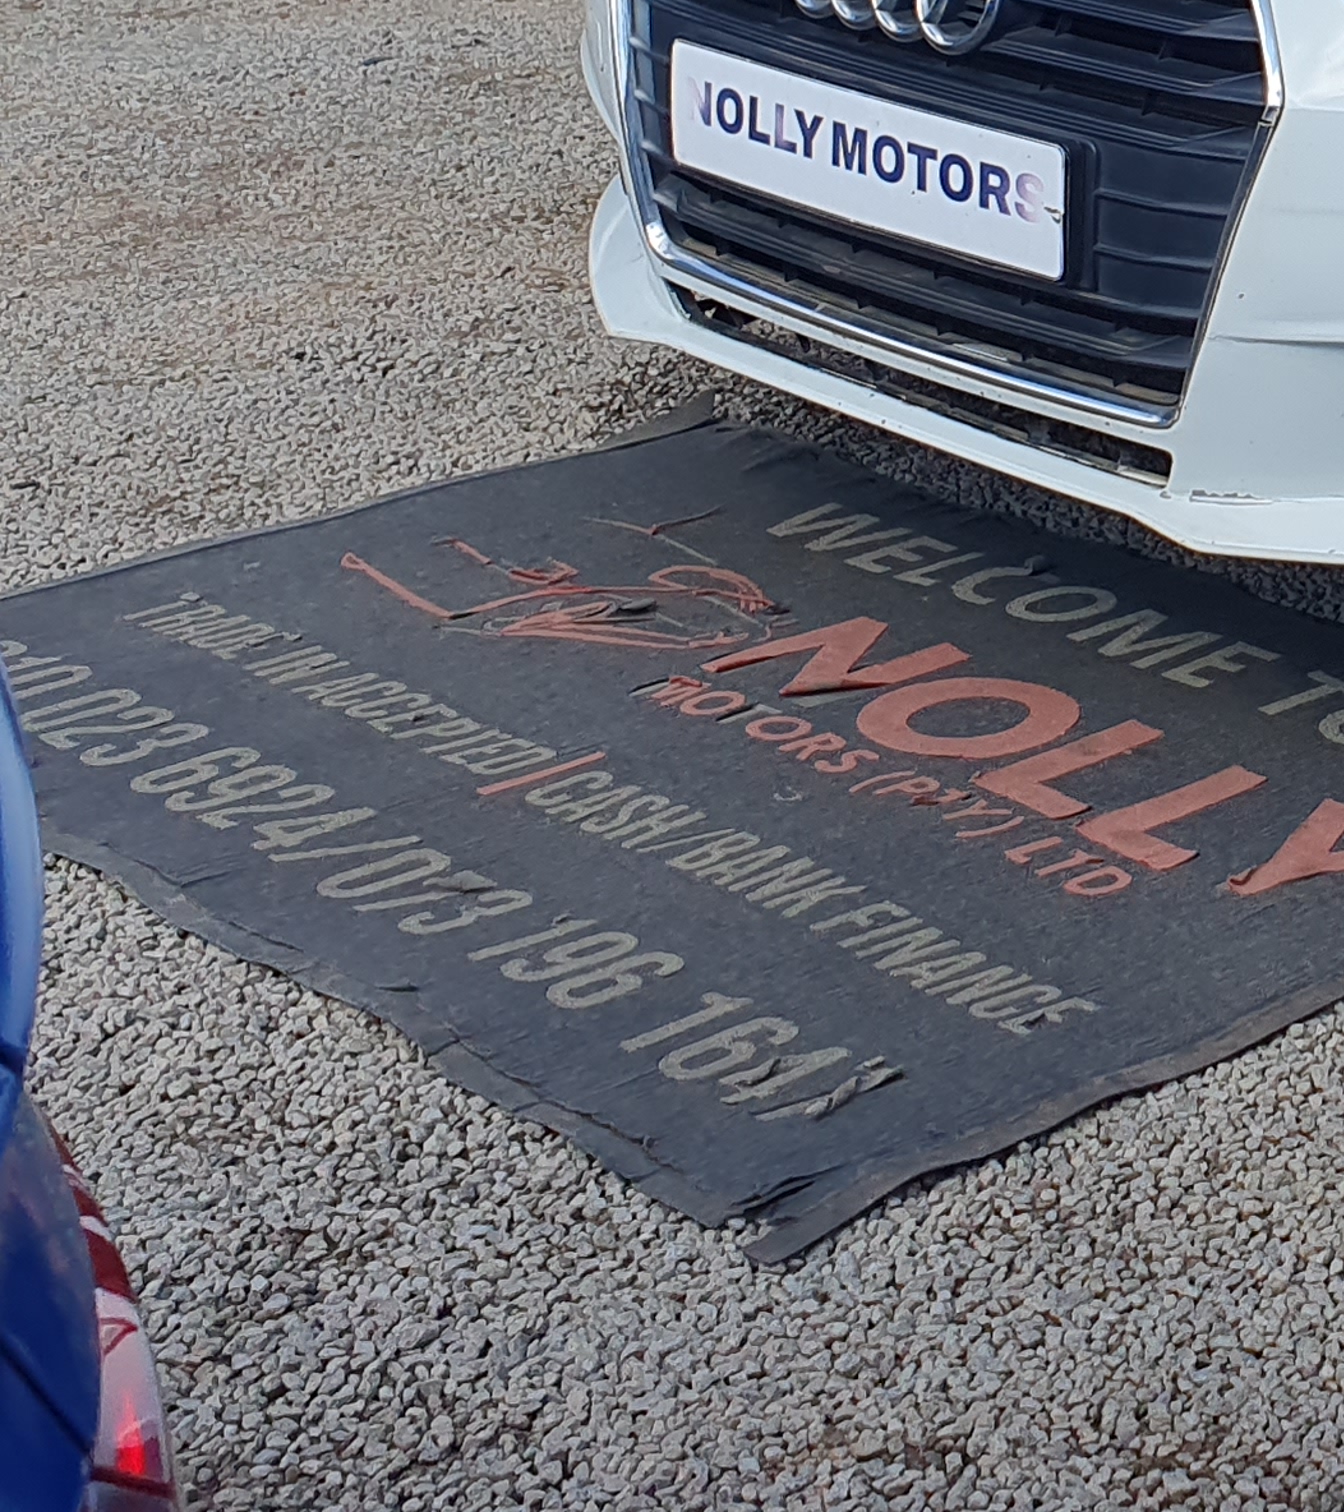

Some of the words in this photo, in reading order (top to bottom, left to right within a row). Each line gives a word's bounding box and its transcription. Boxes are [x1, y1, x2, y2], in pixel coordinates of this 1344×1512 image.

[688, 76, 823, 159] NOLLY
[832, 121, 1044, 223] MOTORS
[766, 502, 1282, 688] WELCOME
[0, 640, 93, 701] 10
[19, 688, 210, 768] 023
[243, 645, 349, 686] IN
[809, 900, 1097, 1035] FINANCE
[1004, 836, 1133, 896] LTD
[467, 915, 685, 1010] 196
